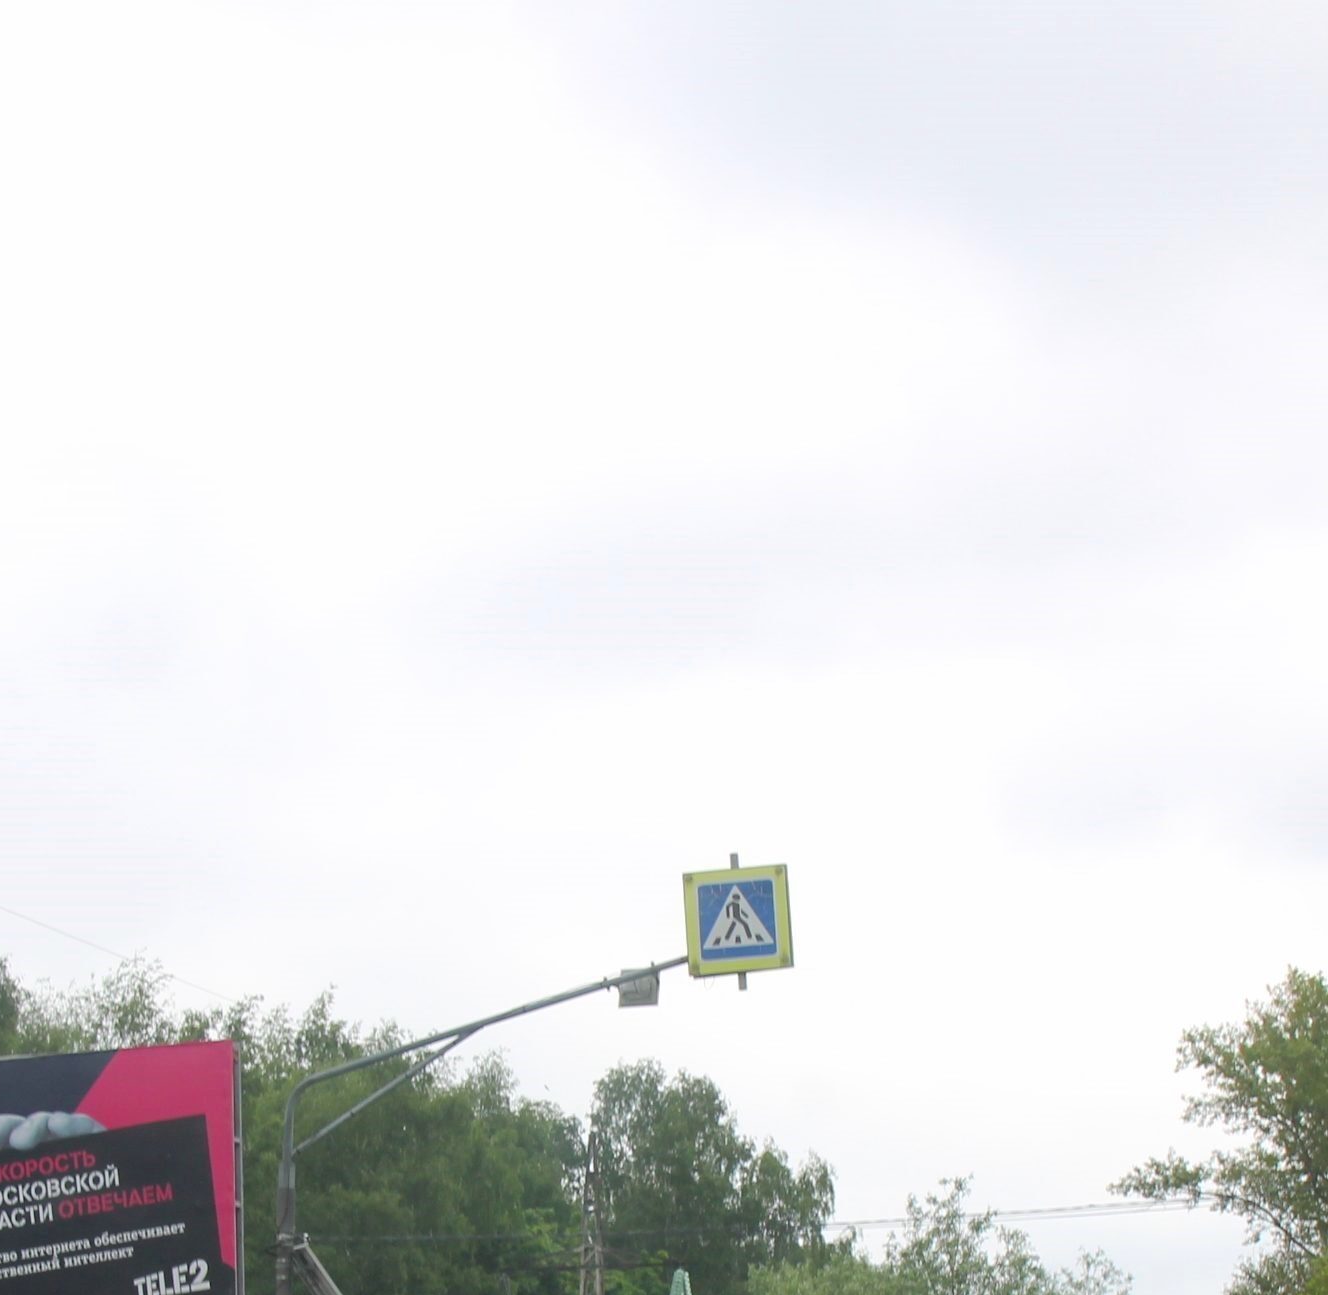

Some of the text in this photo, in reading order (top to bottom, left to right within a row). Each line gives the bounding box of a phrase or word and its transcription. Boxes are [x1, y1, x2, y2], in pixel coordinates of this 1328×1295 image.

[58, 1183, 173, 1219] ОТВЕЧАЕМ
[21, 1238, 91, 1262] интернета
[94, 1223, 186, 1248] обеспечивает
[64, 1246, 135, 1268] интеллект
